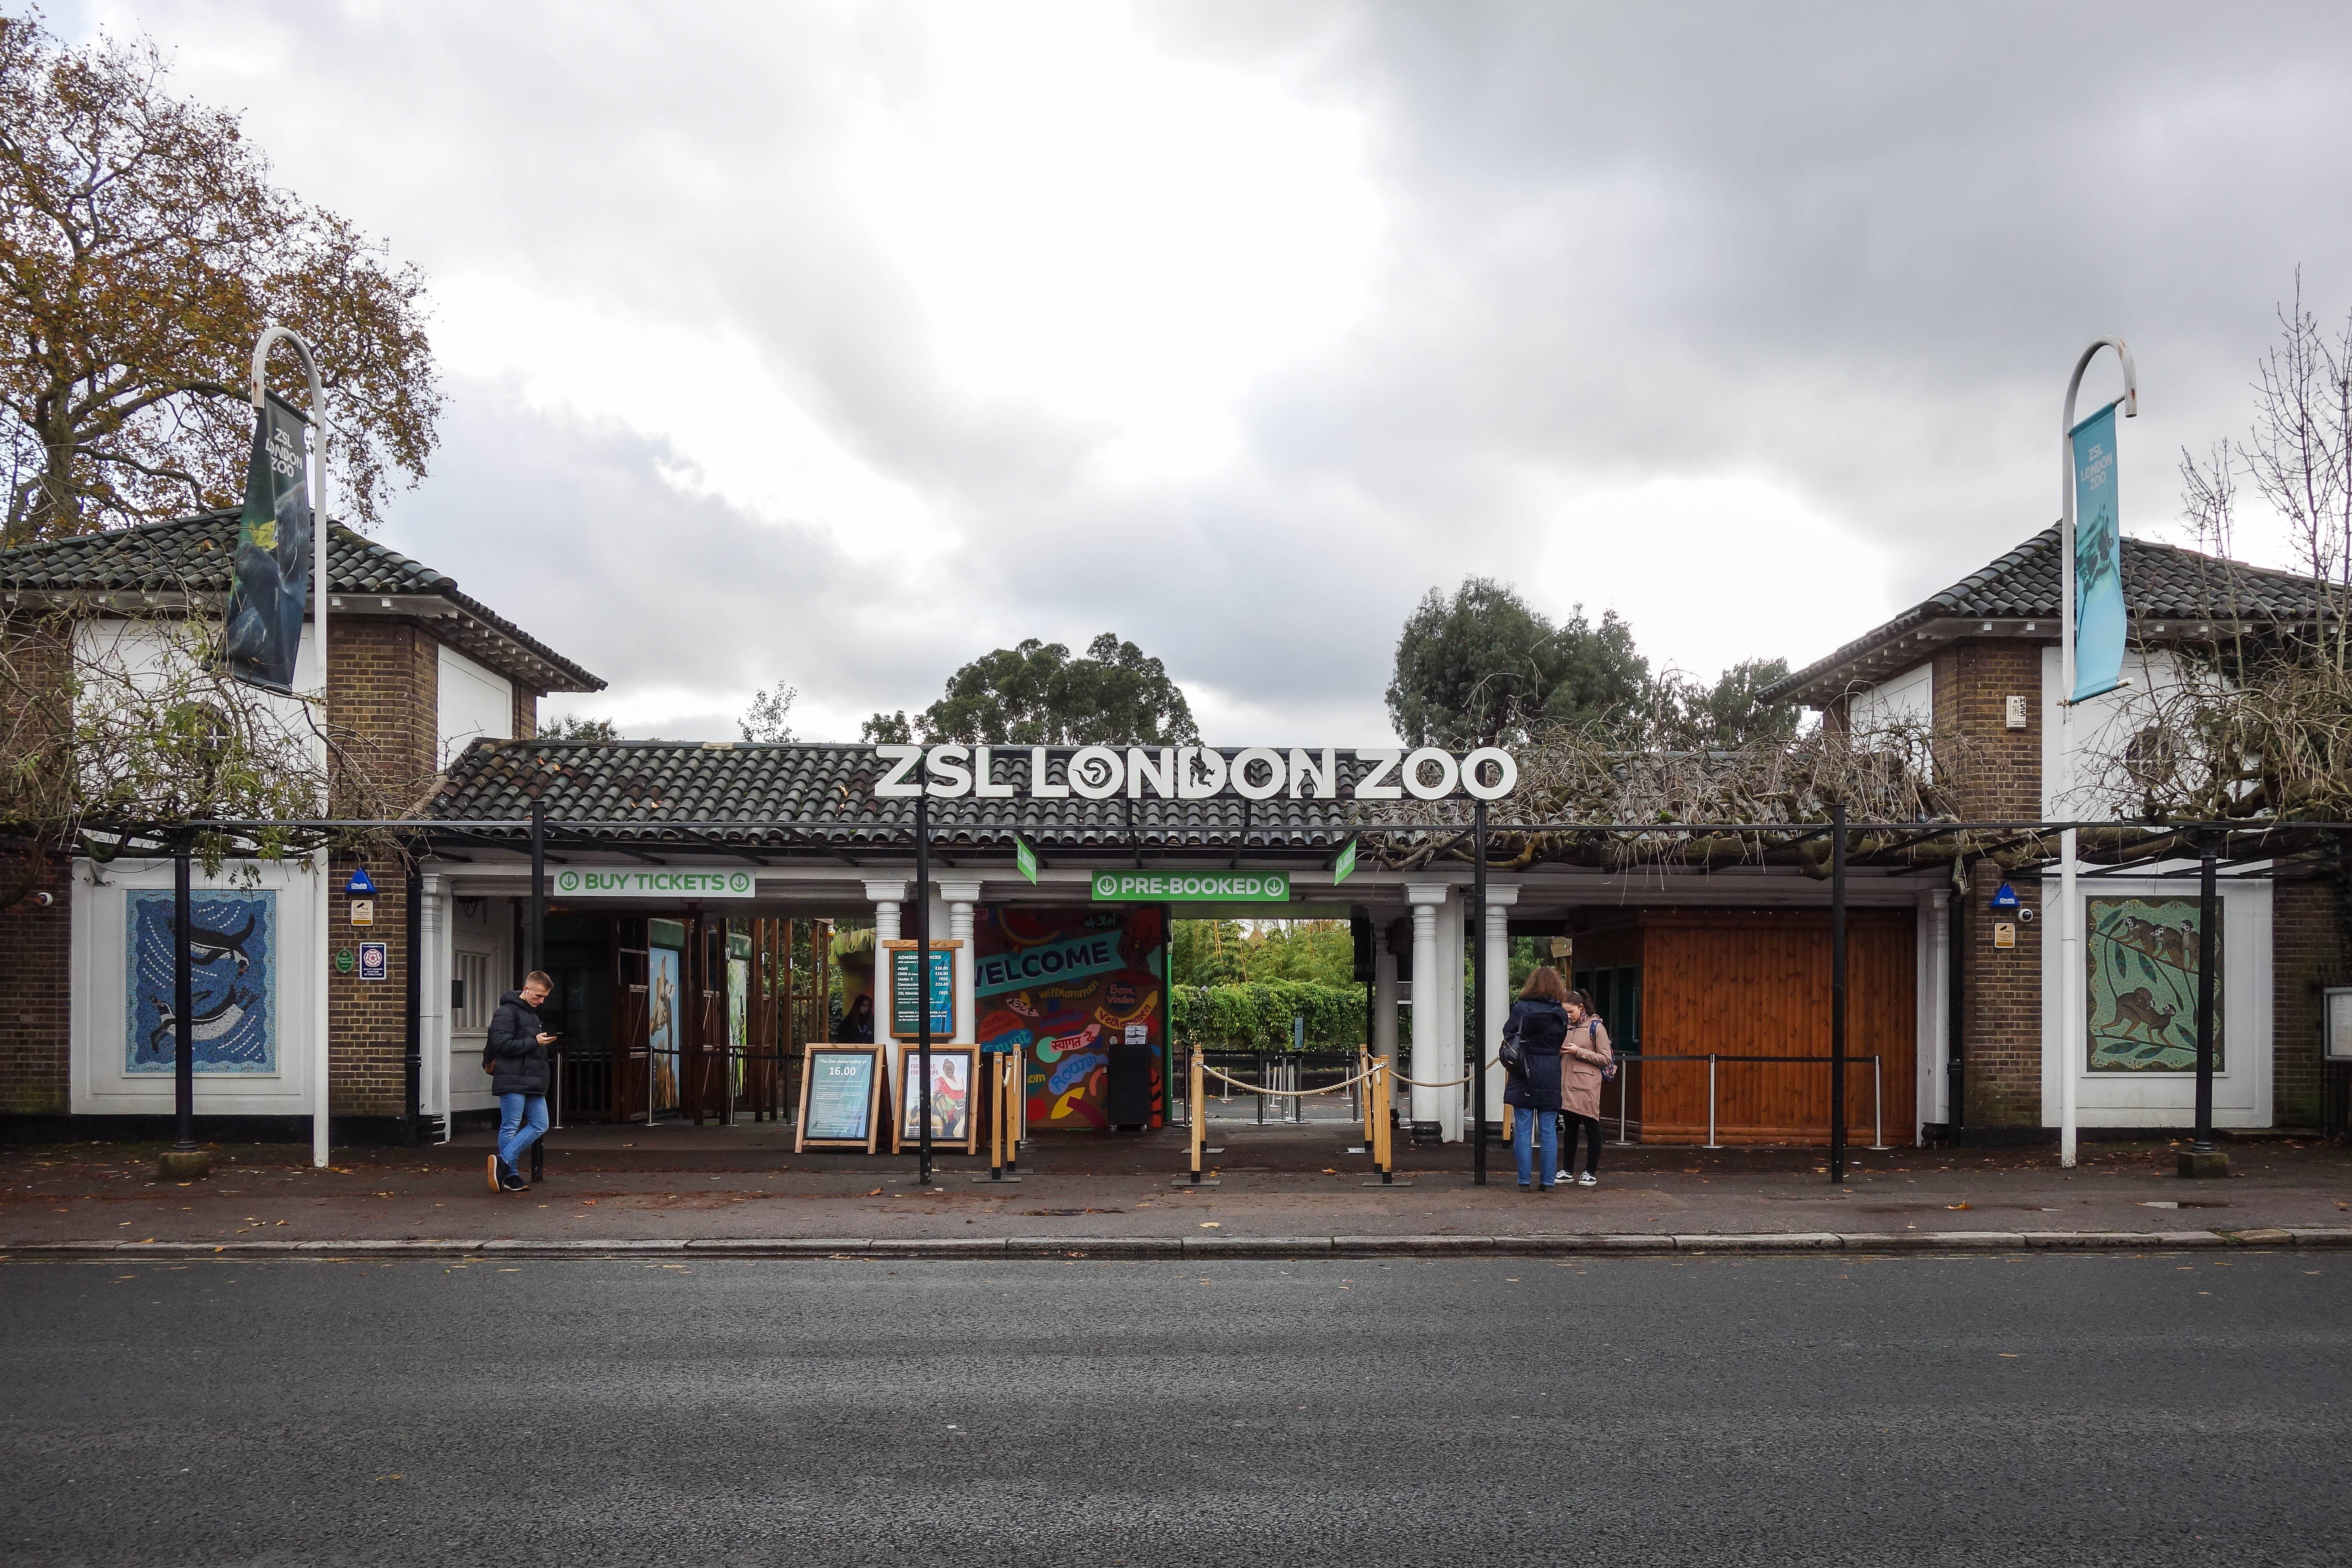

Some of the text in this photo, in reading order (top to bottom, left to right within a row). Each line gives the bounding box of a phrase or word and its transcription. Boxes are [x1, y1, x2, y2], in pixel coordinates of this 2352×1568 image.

[274, 427, 293, 449] ZSL
[2088, 444, 2104, 461] ZSL
[271, 456, 294, 478] ZOO
[2081, 452, 2112, 481] LONDON
[2089, 471, 2106, 491] ZOO
[874, 744, 1518, 799] ZSL LONDON ZOO
[585, 873, 725, 890] BUY TICKETS
[1121, 877, 1261, 894] PRE-BOOKED
[725, 947, 730, 960] 10
[974, 941, 1110, 988] ELCOME
[1008, 998, 1035, 1015] ようこそ
[829, 1066, 856, 1075] 16.00
